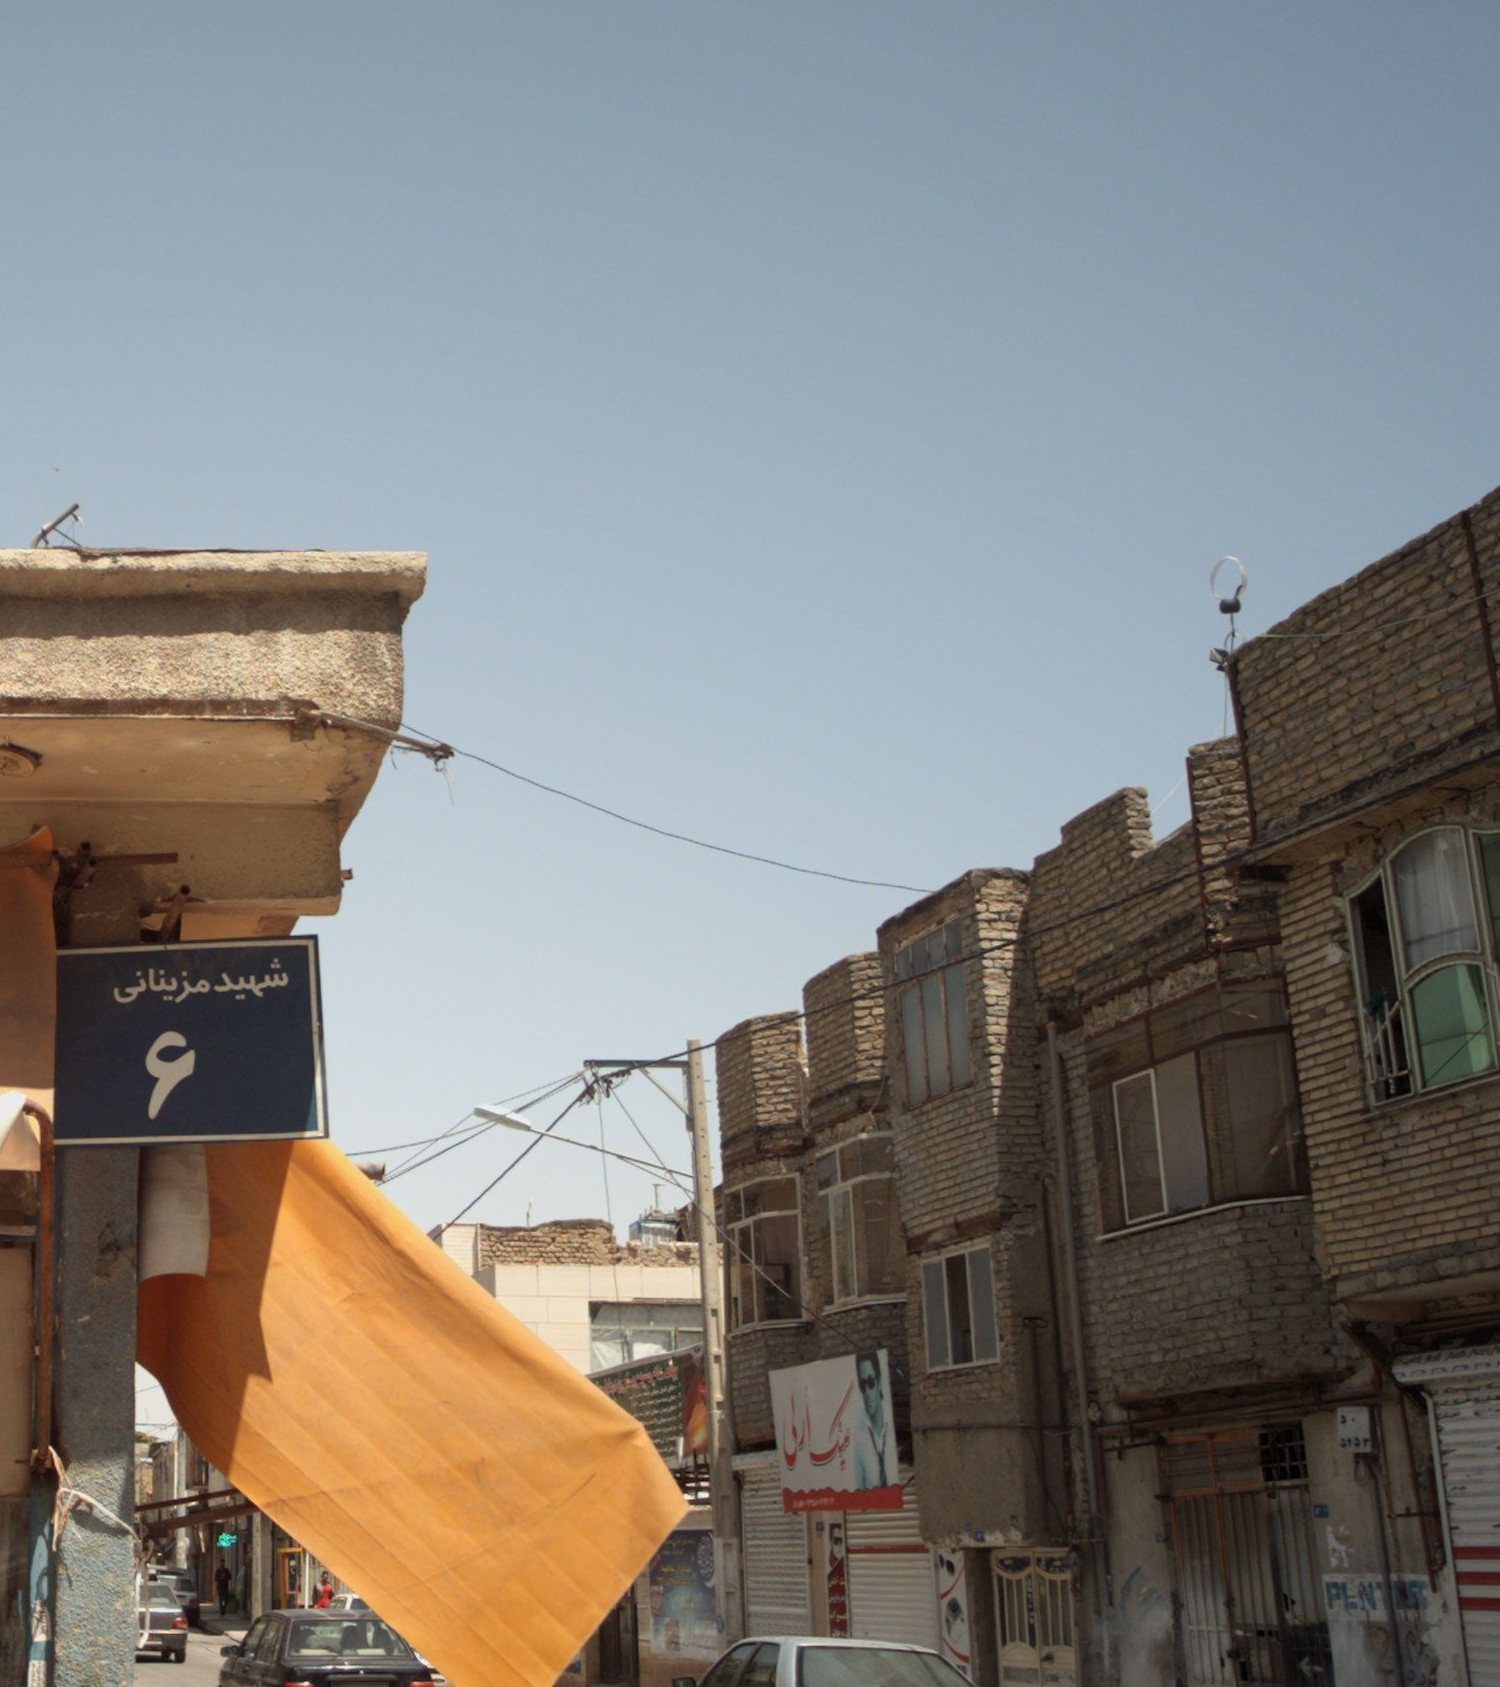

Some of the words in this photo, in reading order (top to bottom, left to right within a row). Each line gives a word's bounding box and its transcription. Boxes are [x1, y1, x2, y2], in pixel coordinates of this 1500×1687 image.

[112, 968, 211, 1004] مزینانی
[213, 957, 289, 1000] شهید
[144, 1030, 197, 1121] ۶
[808, 1380, 854, 1471] عینک
